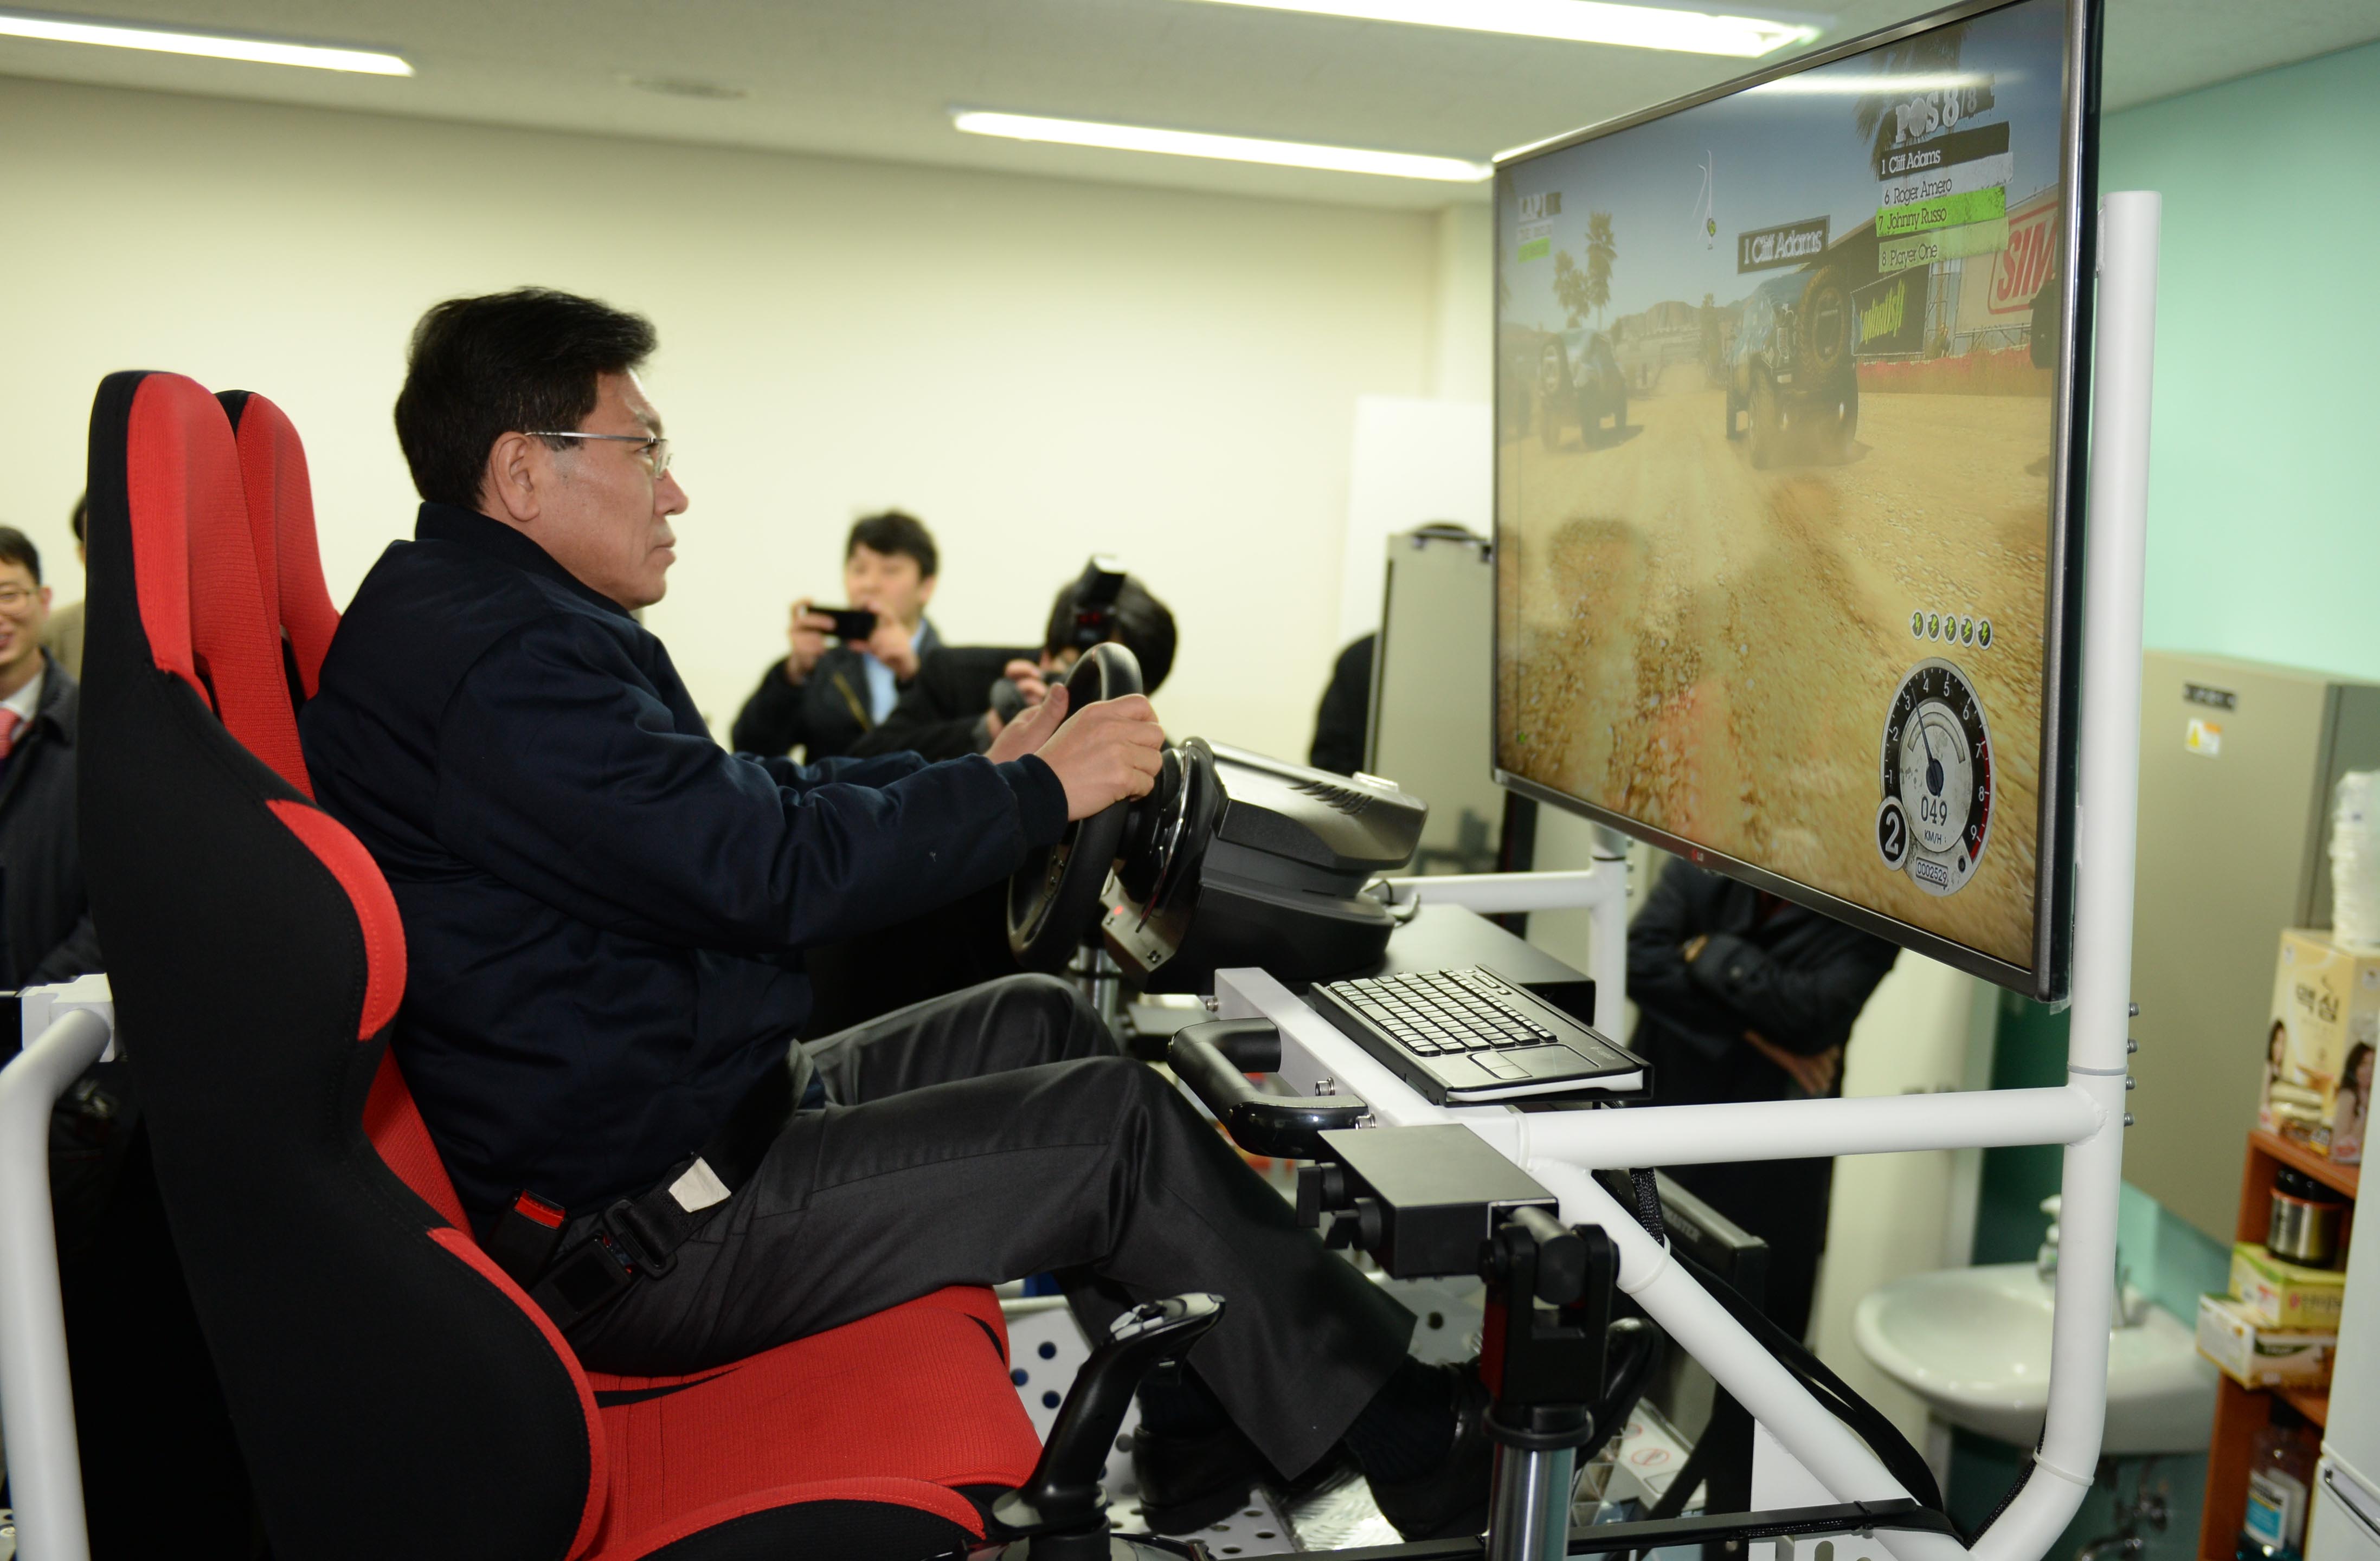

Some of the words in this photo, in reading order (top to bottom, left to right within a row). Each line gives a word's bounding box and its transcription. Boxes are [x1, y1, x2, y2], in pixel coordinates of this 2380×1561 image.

[1895, 91, 1939, 144] POS
[1881, 159, 1886, 175] 1
[1889, 154, 1906, 173] Cliff
[1906, 150, 1941, 170] Adams
[1884, 190, 1890, 205] 6
[1894, 186, 1919, 206] Roger
[1920, 178, 1952, 198] Amero
[1879, 216, 1883, 230] 7
[1887, 212, 1920, 230] Johnny
[1921, 208, 1947, 224] Russo
[1752, 233, 1775, 263] Cliff
[1774, 229, 1823, 259] Adams
[1882, 251, 1887, 266] 8
[1890, 248, 1916, 268] Player
[1918, 243, 1938, 260] One
[1923, 678, 1929, 693] 4
[1944, 681, 1950, 696] 5
[1905, 695, 1911, 711] 3
[1963, 705, 1969, 720] 6
[1892, 726, 1898, 741] 2
[1976, 743, 1981, 758] 7
[1889, 769, 1893, 784] 1
[1978, 786, 1984, 802] 8
[1921, 796, 1947, 827] 049
[1885, 811, 1900, 855] 2
[1924, 829, 1942, 845] KM/H
[1970, 824, 1977, 840] 9
[1917, 862, 1947, 883] 0002529
